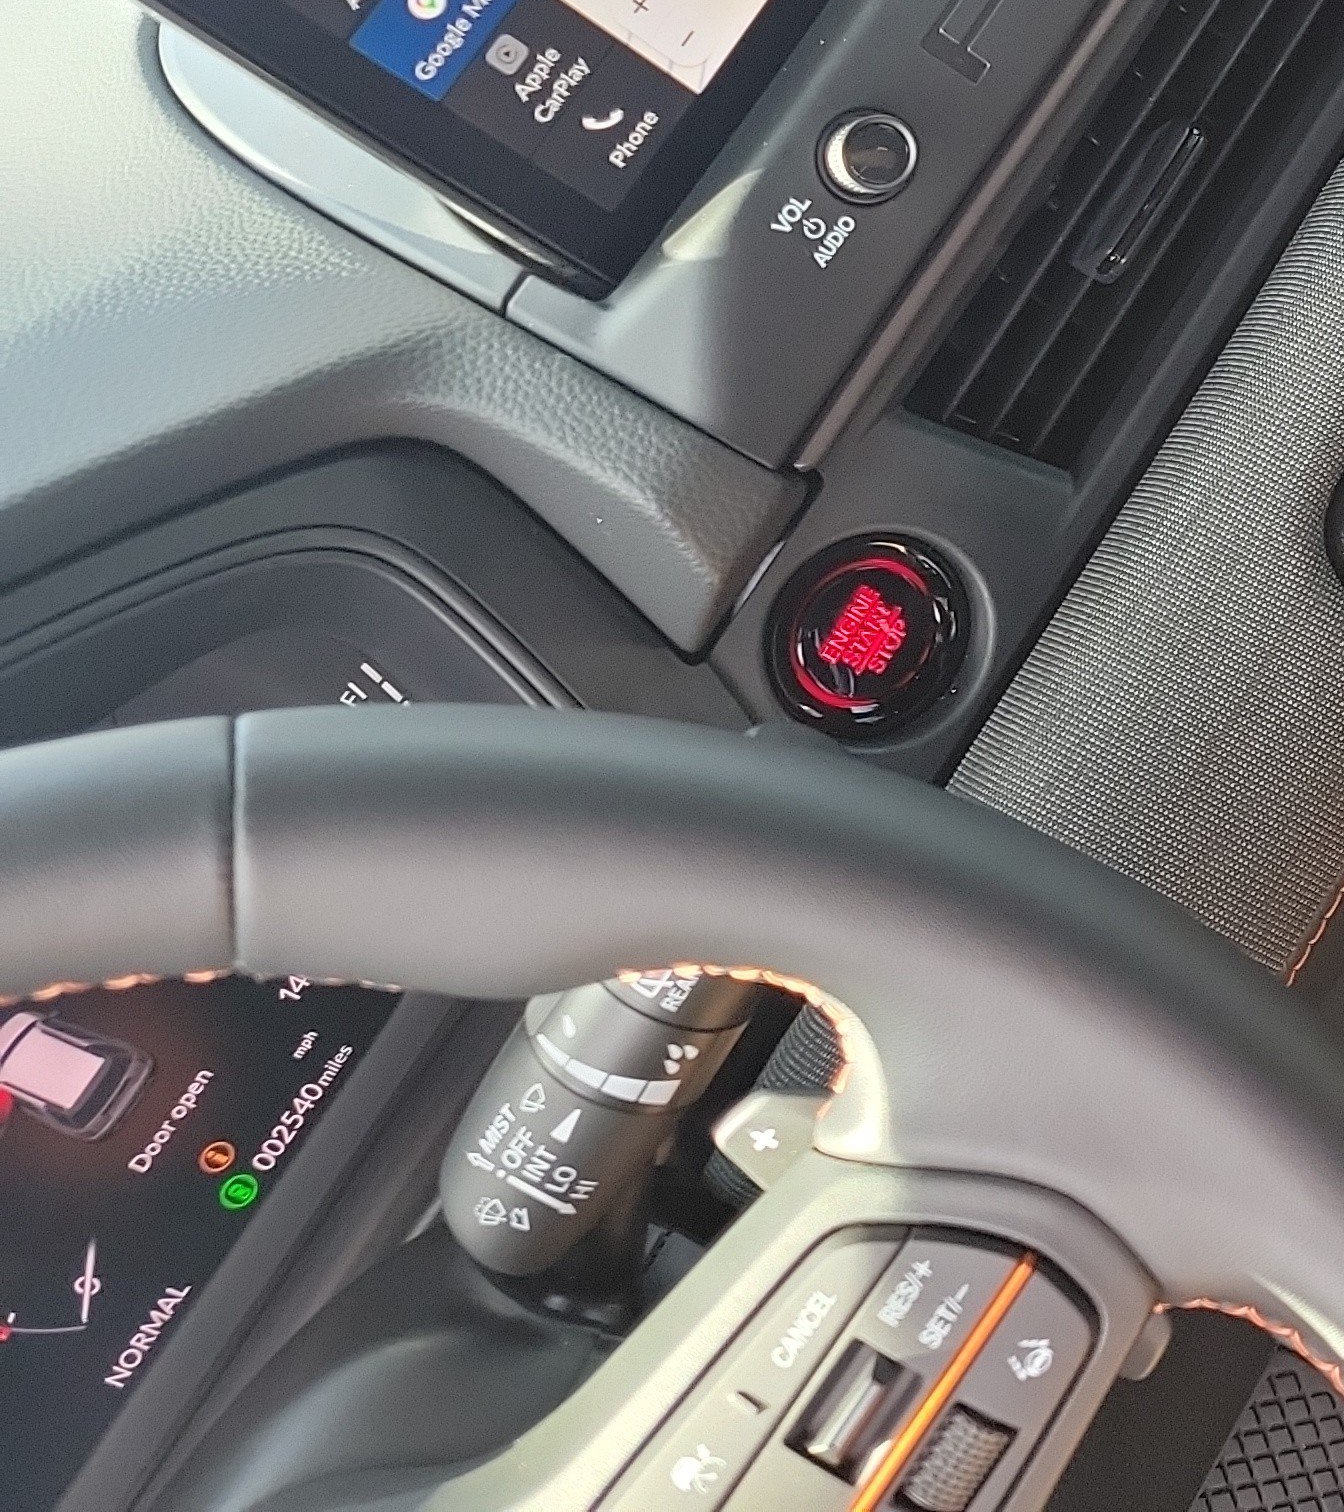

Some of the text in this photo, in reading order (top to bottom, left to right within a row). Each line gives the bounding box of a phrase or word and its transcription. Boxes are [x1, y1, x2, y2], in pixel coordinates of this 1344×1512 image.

[415, 18, 470, 82] Google
[515, 46, 562, 104] Apple
[534, 56, 592, 124] CarPlay
[609, 110, 660, 169] Phone
[770, 197, 812, 234] VOL
[813, 215, 856, 269] AUDIO
[821, 586, 881, 665] ENGINE
[868, 618, 907, 674] STOP
[279, 973, 311, 1001] 14
[660, 976, 700, 1013] REA
[293, 1030, 320, 1060] mph
[128, 1068, 215, 1175] Door open
[252, 1043, 354, 1173] 002540 miles
[479, 1102, 516, 1155] MIST
[501, 1125, 534, 1170] OFF
[520, 1144, 558, 1183] INT
[544, 1165, 578, 1193] LO
[568, 1180, 600, 1200] HI
[877, 1260, 933, 1328] RES/+
[104, 1284, 193, 1389] NORMAL
[771, 1290, 838, 1368] CANCEL
